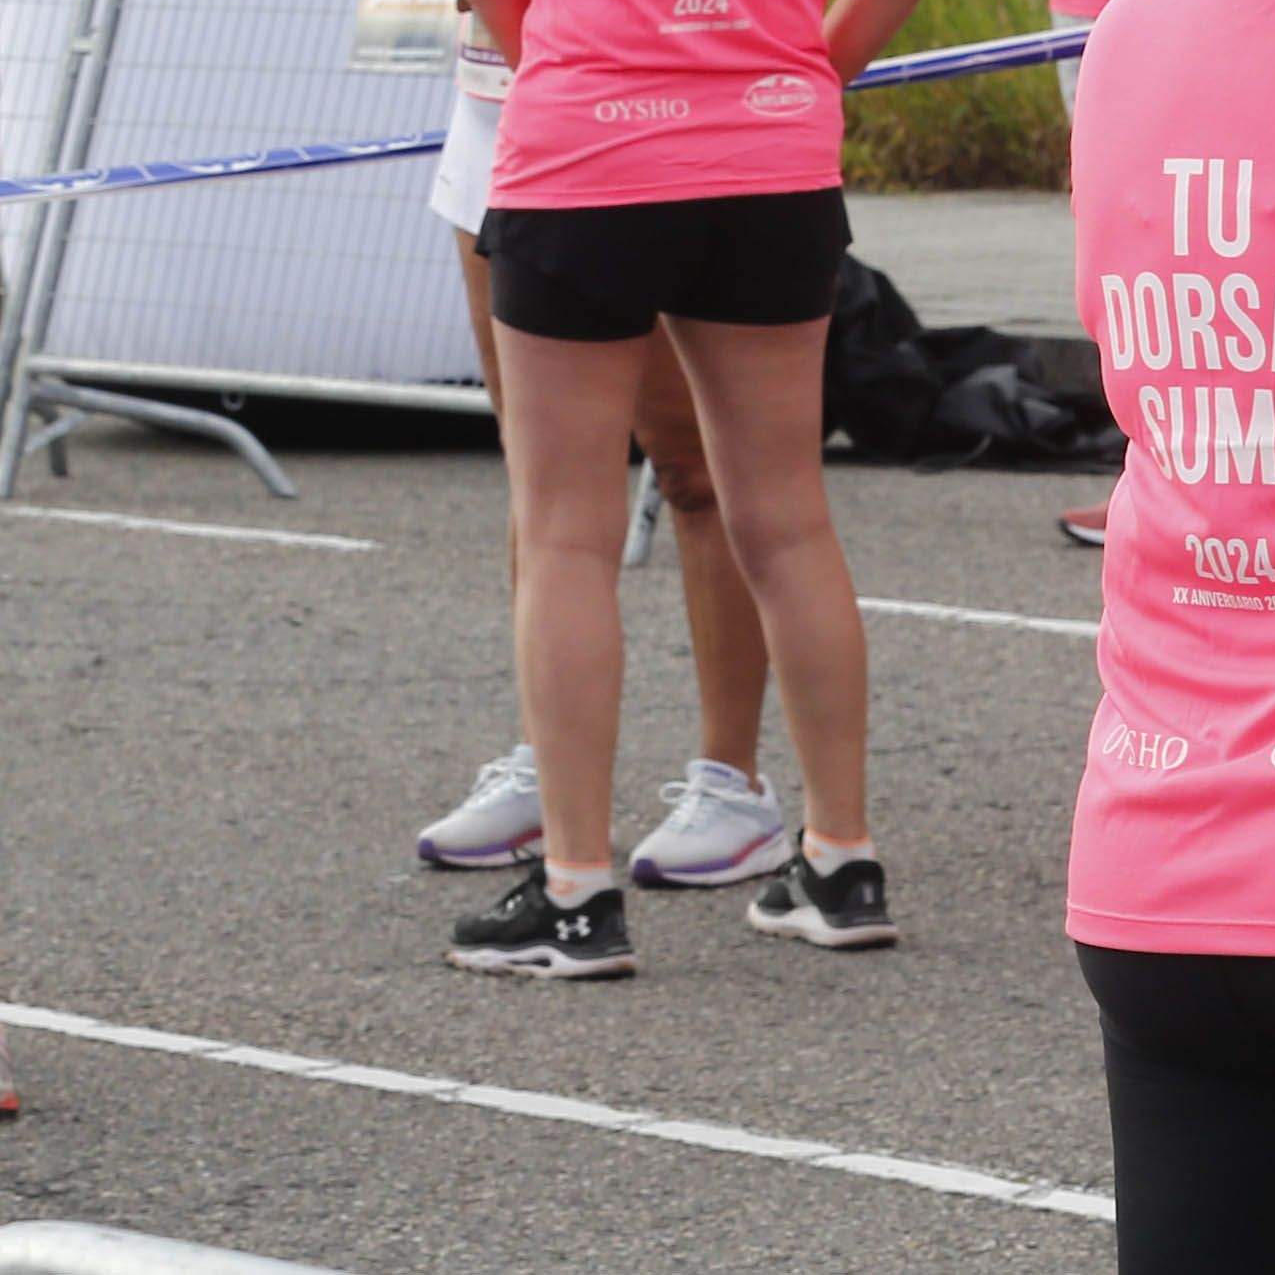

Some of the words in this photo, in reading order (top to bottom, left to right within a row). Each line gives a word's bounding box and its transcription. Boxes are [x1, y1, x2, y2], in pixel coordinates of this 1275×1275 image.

[594, 97, 690, 124] OYSHO
[1162, 157, 1254, 259] TU
[1172, 586, 1189, 604] XX
[1190, 588, 1265, 611] ANIVERSARIO
